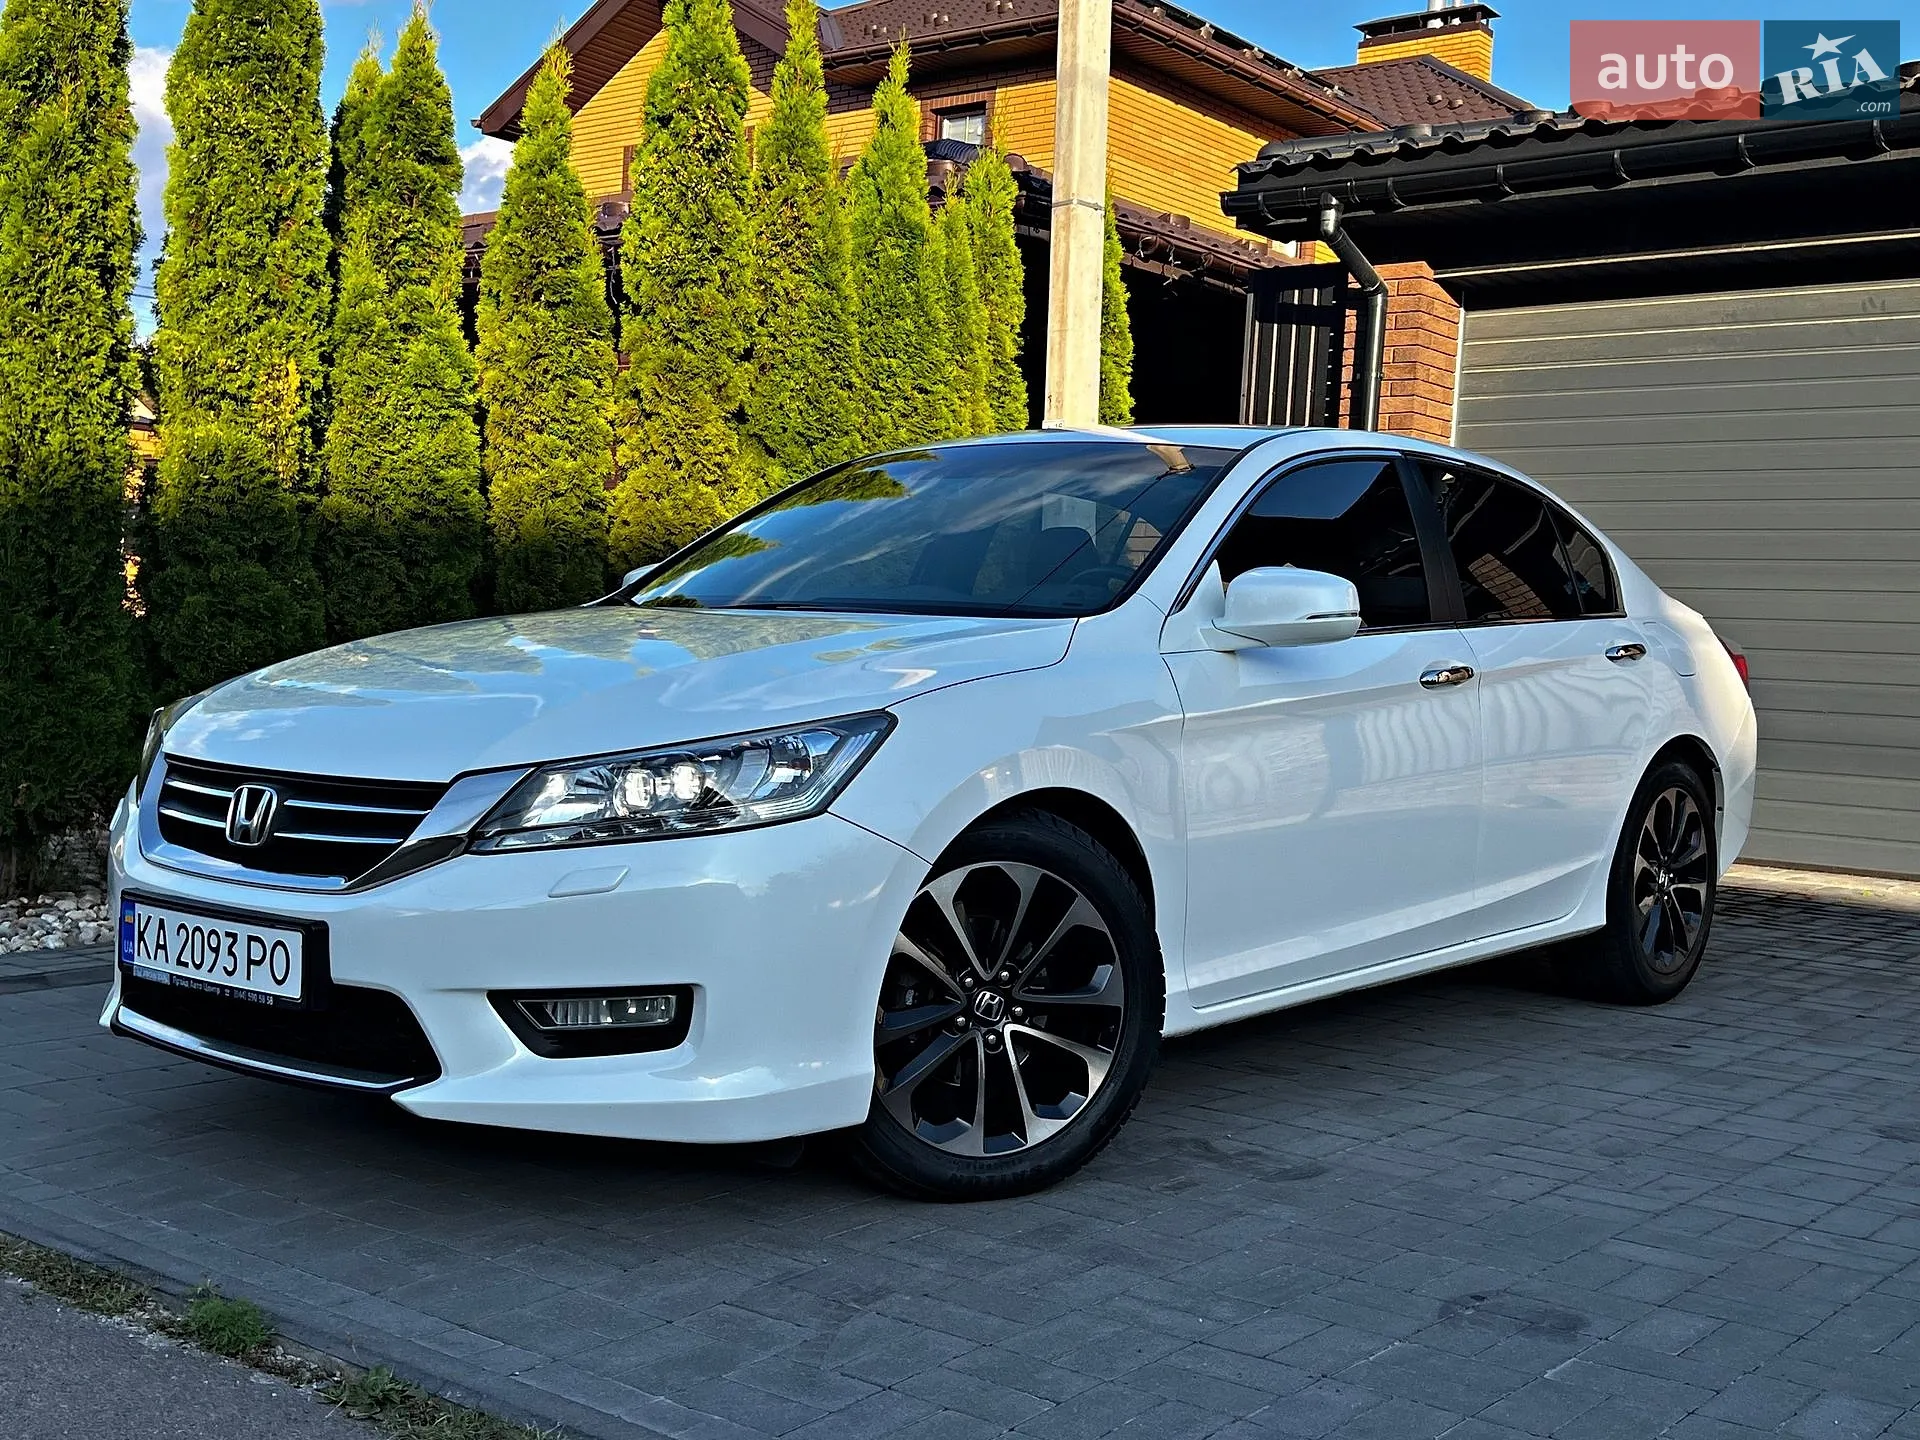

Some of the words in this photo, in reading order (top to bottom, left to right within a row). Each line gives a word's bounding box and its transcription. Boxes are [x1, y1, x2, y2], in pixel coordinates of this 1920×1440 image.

[123, 939, 134, 955] UA
[137, 912, 170, 964] KA
[175, 922, 239, 977] 2093
[246, 933, 291, 986] PO
